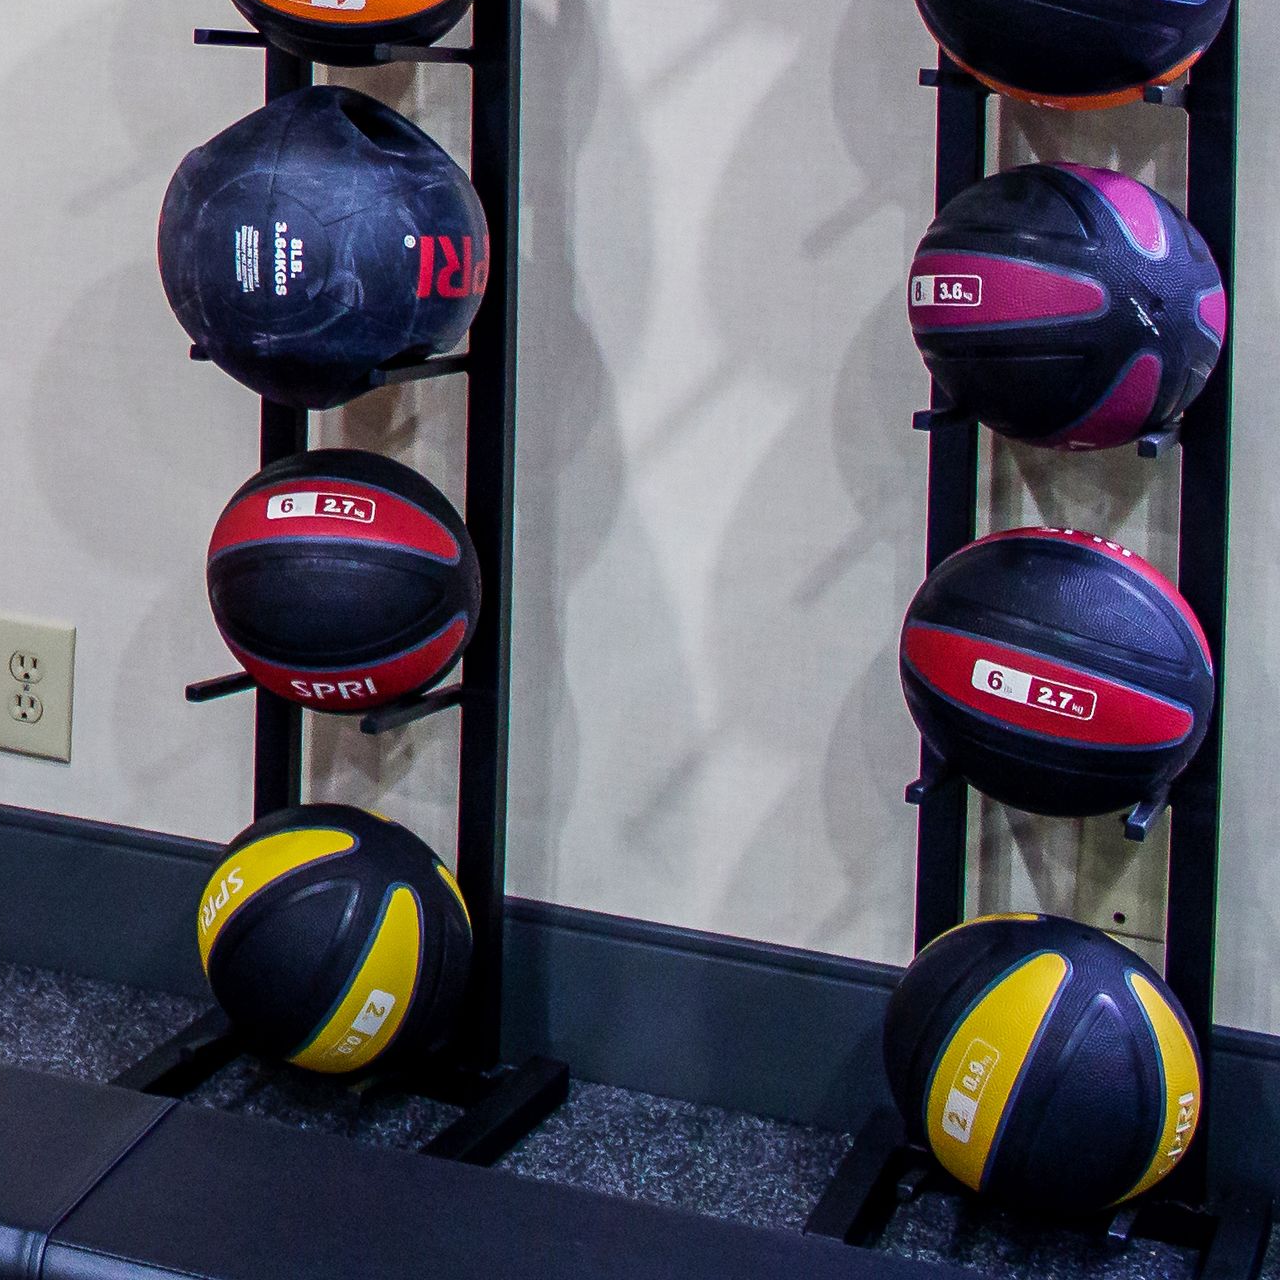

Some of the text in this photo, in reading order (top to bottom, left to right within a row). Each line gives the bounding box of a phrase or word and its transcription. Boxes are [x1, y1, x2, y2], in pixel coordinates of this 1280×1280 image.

[274, 221, 288, 296] 3.64KGS
[290, 238, 303, 279] 8LB.
[940, 283, 962, 299] 3.6
[281, 498, 293, 513] 6
[323, 499, 354, 514] 2.7
[291, 677, 377, 699] SPRI
[988, 671, 1003, 690] 6
[1037, 687, 1073, 708] 2.7
[202, 868, 244, 935] SPRI
[366, 1001, 385, 1017] 2
[948, 1111, 967, 1131] 2
